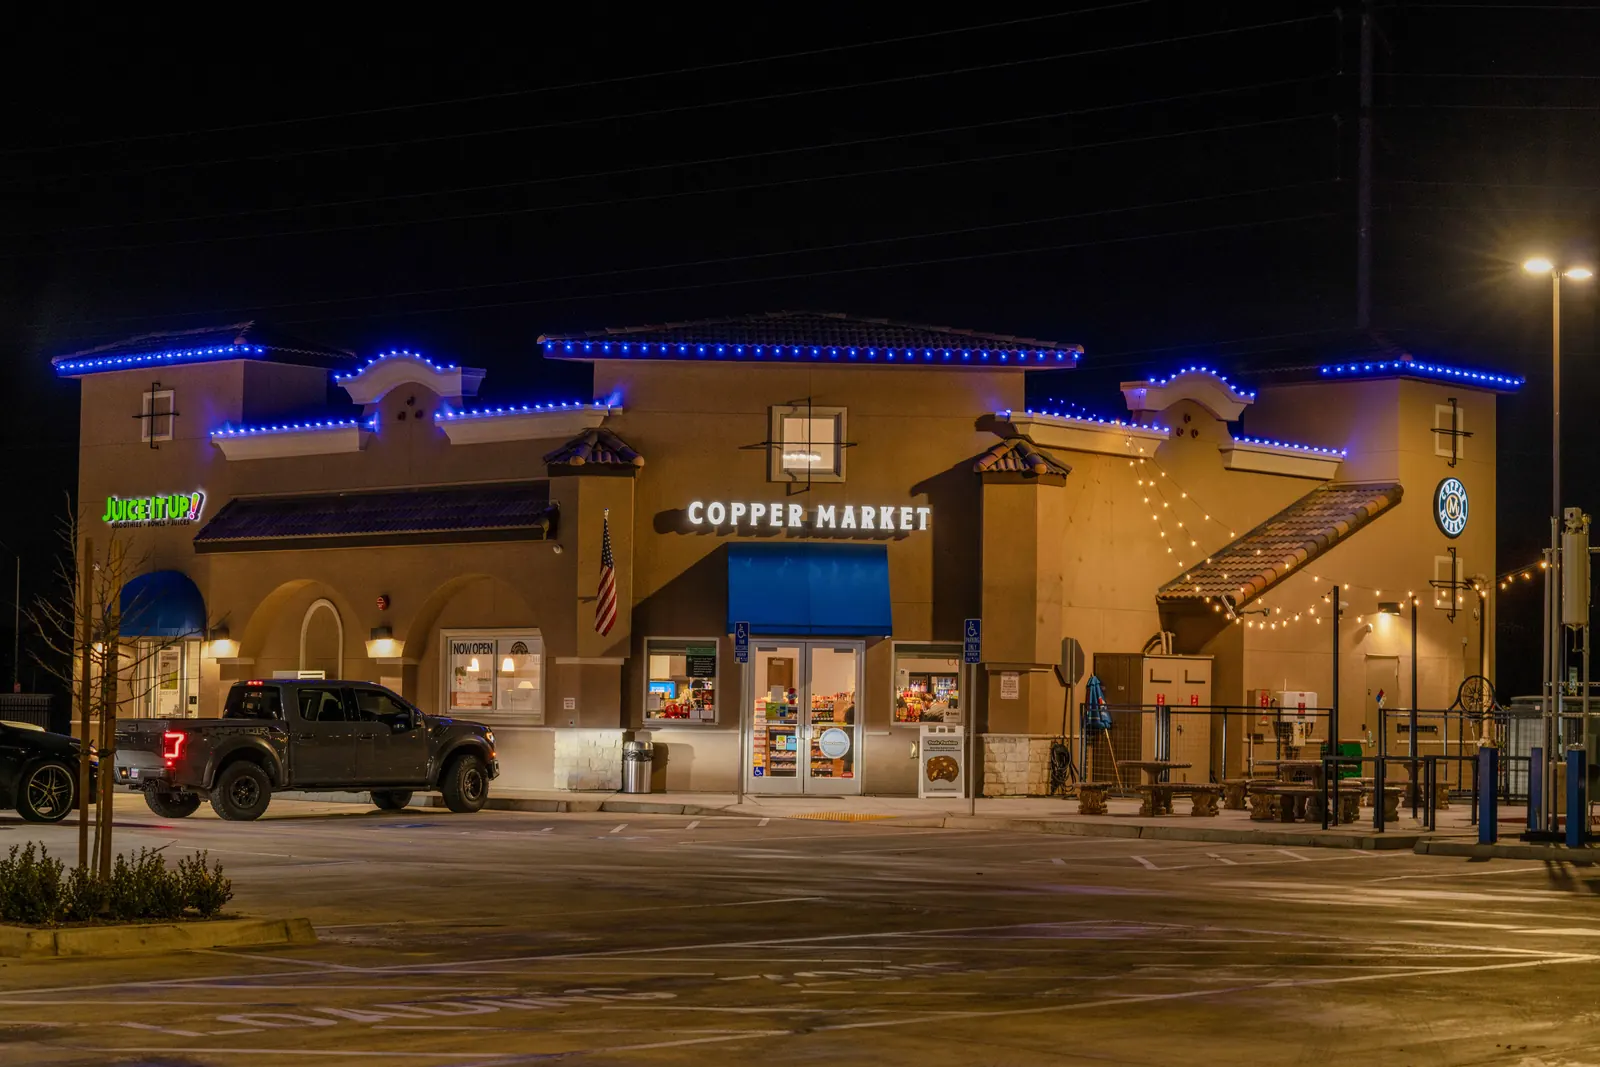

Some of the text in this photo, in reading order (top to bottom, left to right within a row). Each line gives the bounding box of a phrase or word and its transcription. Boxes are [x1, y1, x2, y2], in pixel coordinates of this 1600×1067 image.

[1441, 481, 1466, 501] COPPER
[102, 491, 203, 521] JUICE IT UP!
[688, 501, 930, 530] COPPER MARKET
[453, 643, 493, 654] NOW OPEN
[120, 987, 678, 1037] LOADING
